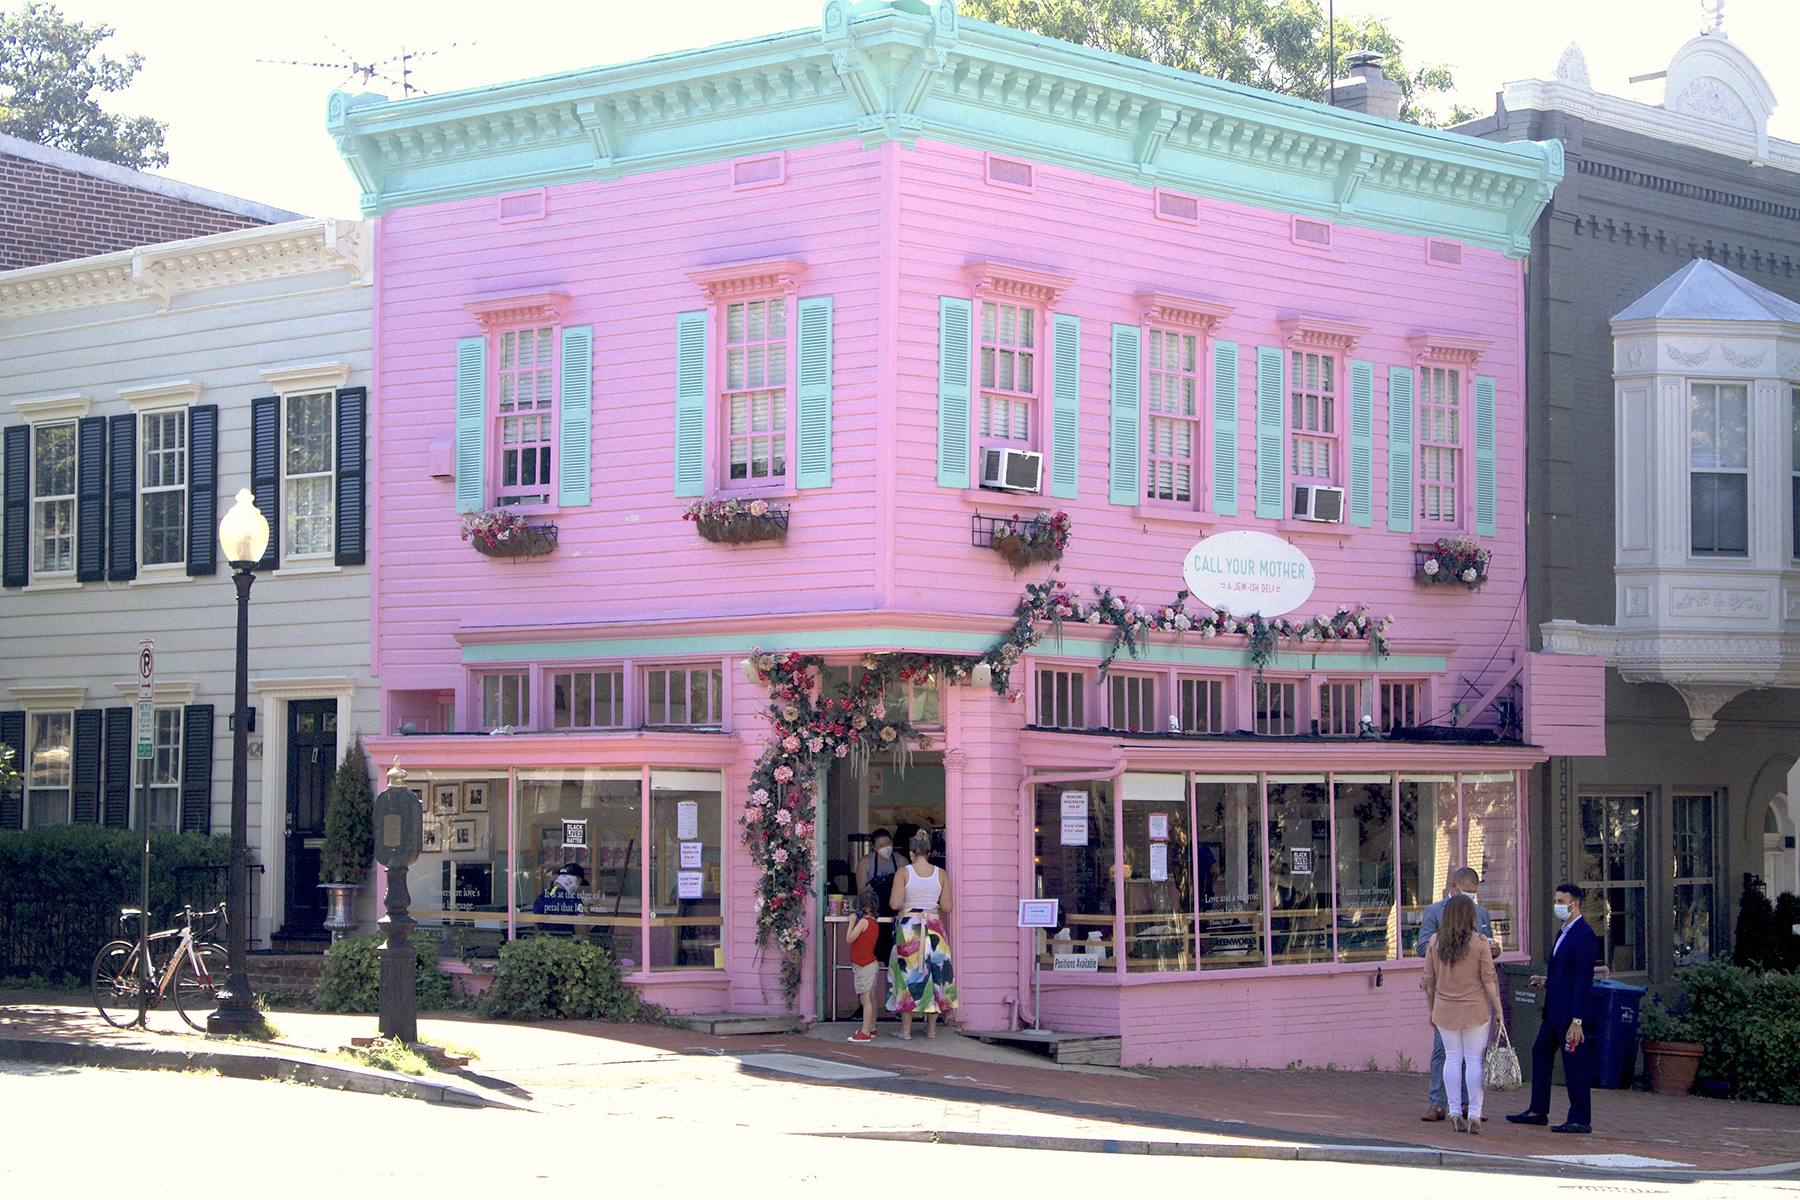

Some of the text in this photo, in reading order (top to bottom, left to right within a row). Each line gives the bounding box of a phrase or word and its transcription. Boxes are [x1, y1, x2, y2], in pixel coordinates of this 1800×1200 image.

[1194, 555, 1305, 580] CALL YOUR MOTHER
[1227, 582, 1275, 593] A JEW-ISH DELI
[463, 888, 480, 897] love's
[544, 888, 549, 898] It
[558, 891, 564, 899] at
[566, 890, 575, 900] the
[576, 890, 592, 902] edge
[593, 890, 601, 900] of
[1205, 894, 1219, 903] Love
[1220, 893, 1230, 902] and
[1361, 899, 1370, 907] and
[544, 902, 559, 914] petal
[561, 903, 573, 912] that
[590, 904, 608, 913] waits.
[1226, 906, 1233, 915] be
[1210, 938, 1256, 948] GREENWORKS
[1055, 958, 1096, 968] Positions Available
